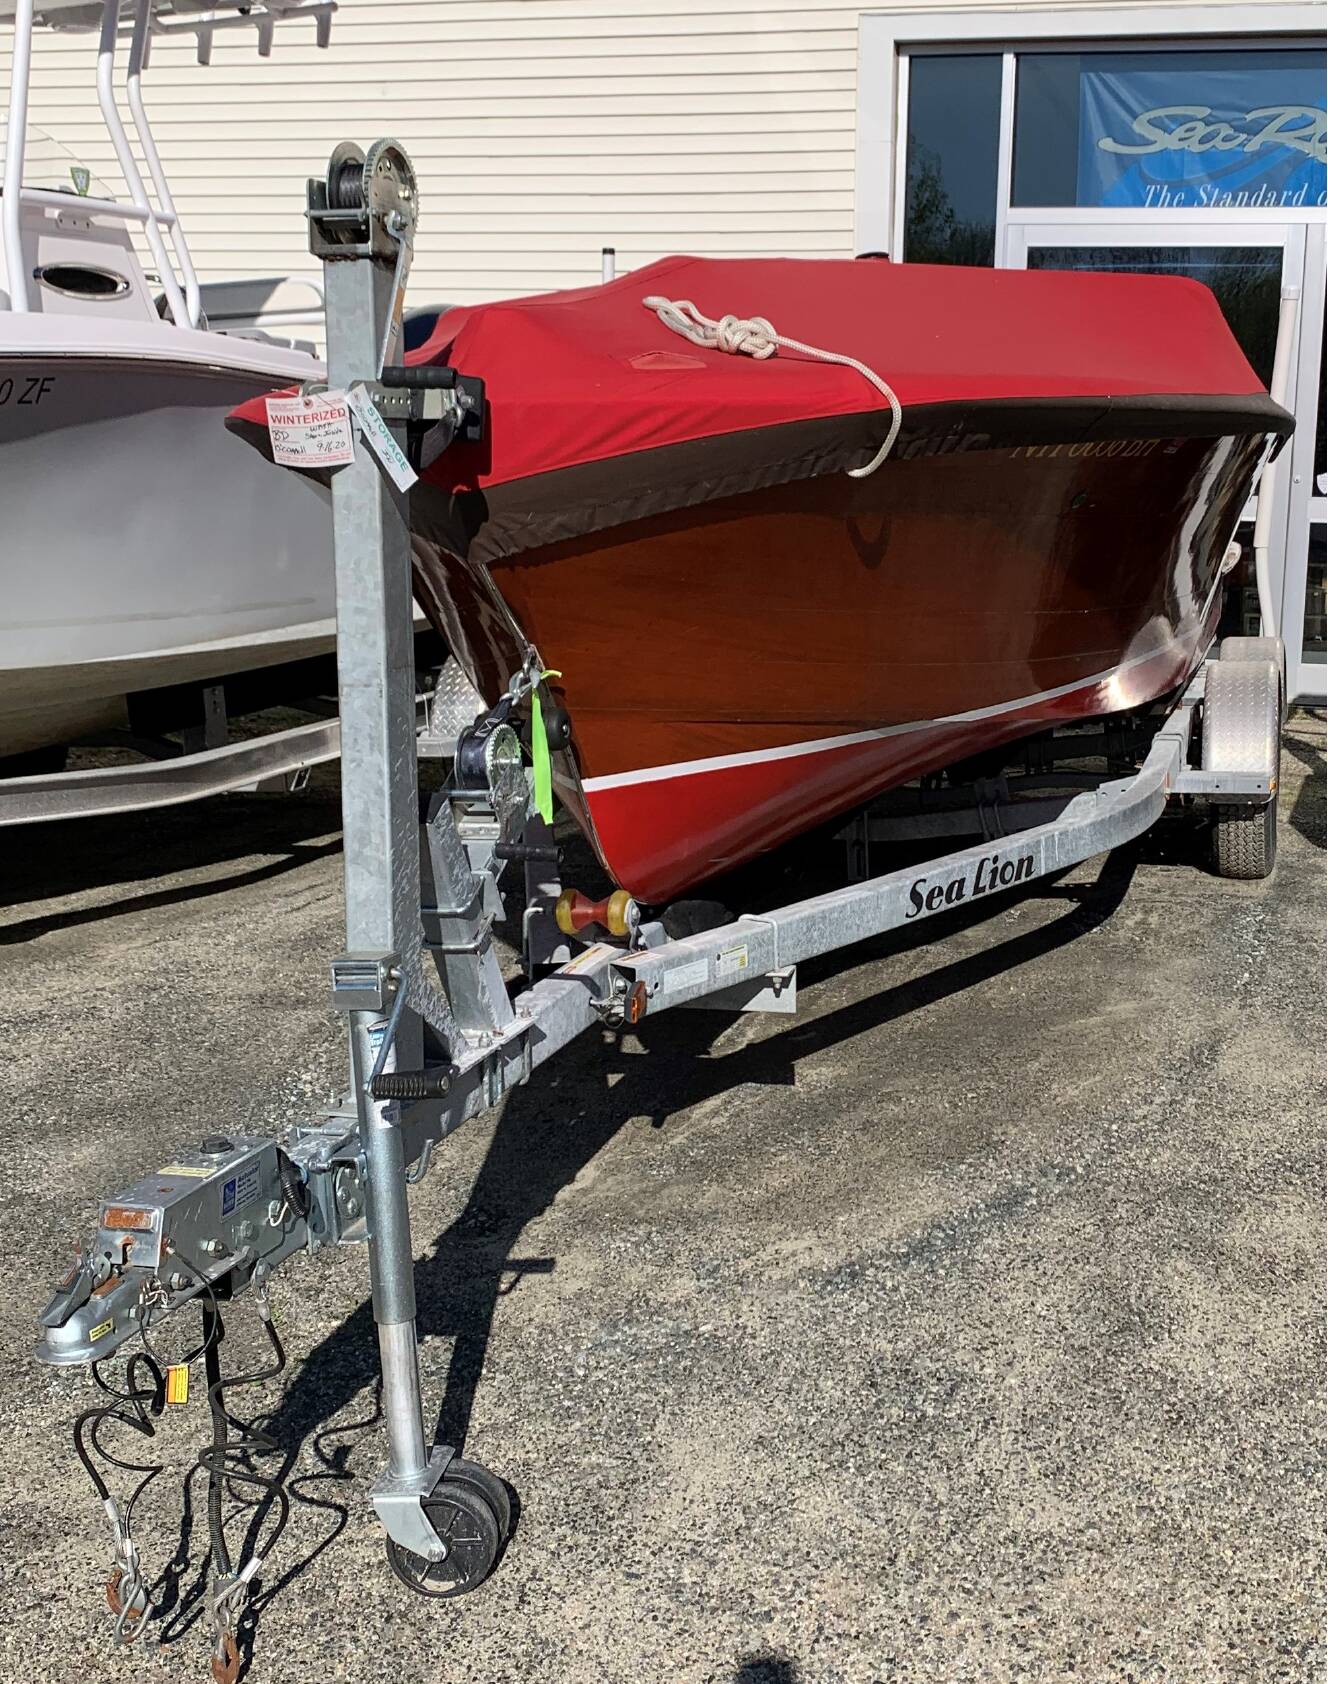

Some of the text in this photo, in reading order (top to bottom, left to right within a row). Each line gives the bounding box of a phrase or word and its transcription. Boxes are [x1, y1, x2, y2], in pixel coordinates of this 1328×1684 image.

[1098, 105, 1247, 154] Sea
[1144, 184, 1186, 208] The
[1194, 183, 1309, 208] Standard
[17, 377, 56, 405] ZF
[270, 407, 346, 425] WINTERIZED
[367, 407, 409, 472] STORAGE
[905, 855, 1036, 919] Sea Lion
